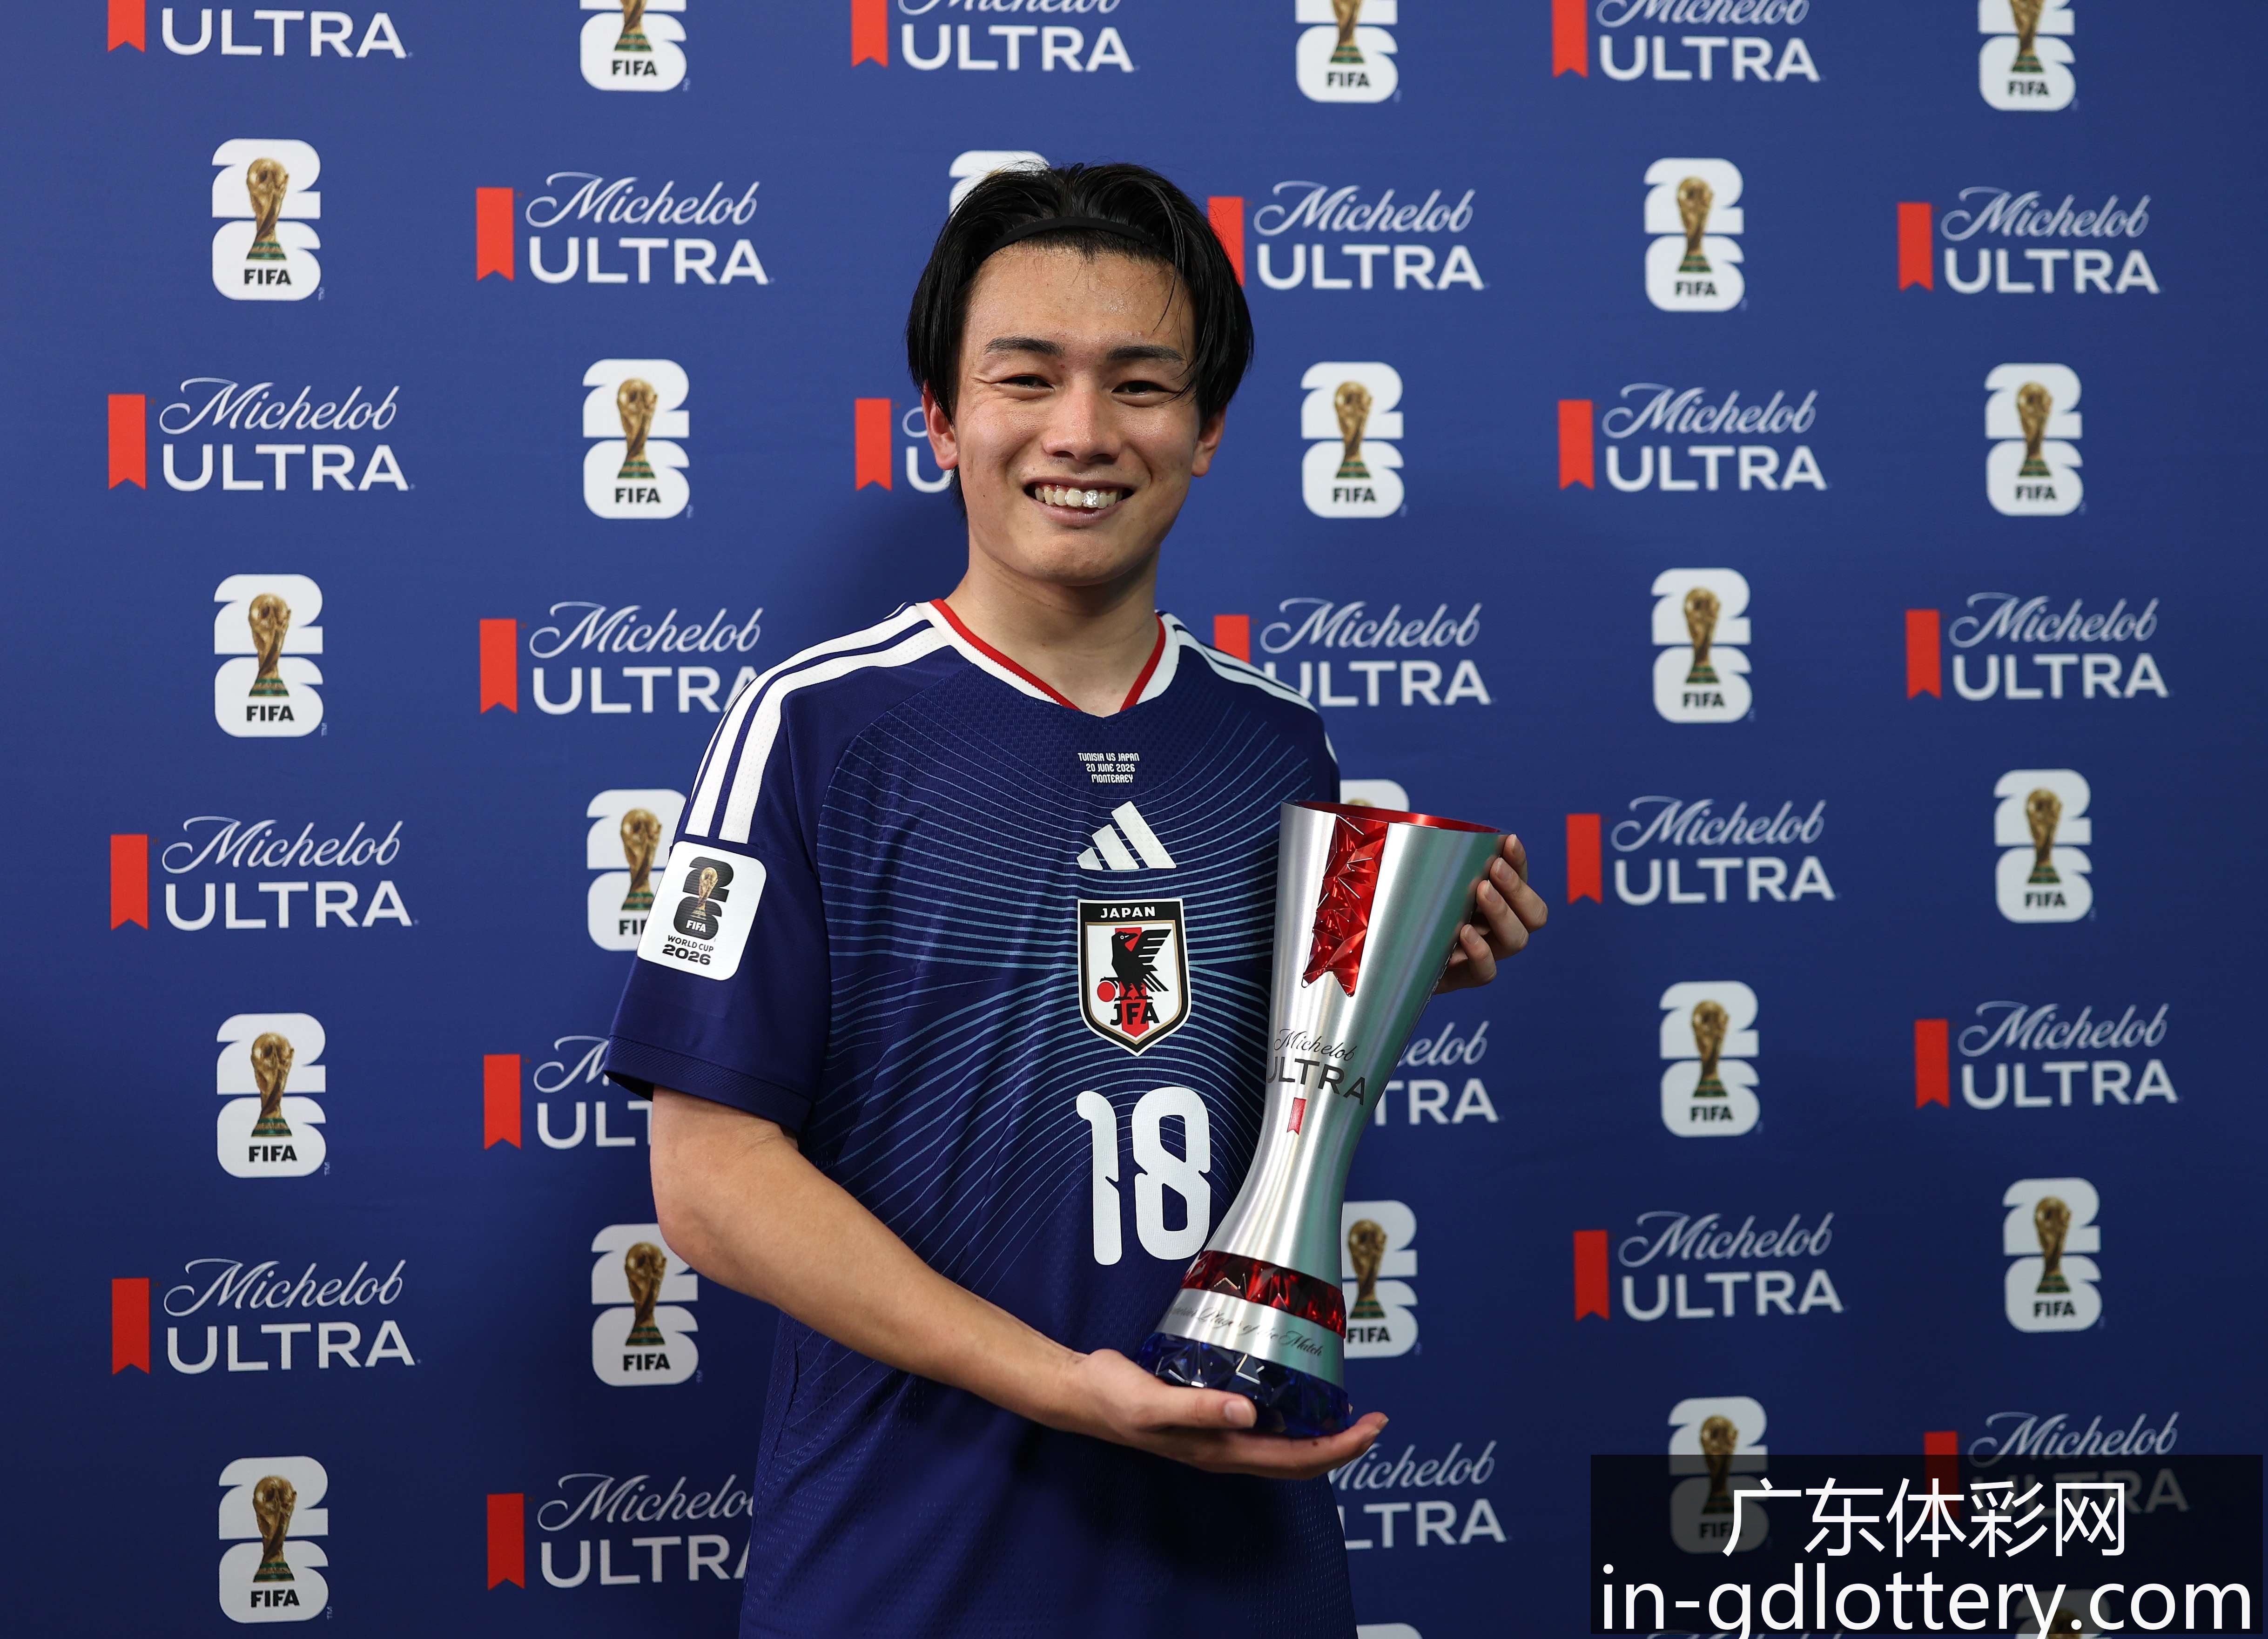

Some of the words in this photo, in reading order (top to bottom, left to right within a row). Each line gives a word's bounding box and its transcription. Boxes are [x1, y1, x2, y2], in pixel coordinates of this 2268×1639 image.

[162, 7, 407, 59] ULTRA
[901, 23, 1135, 73] ULTRA
[612, 60, 657, 76] FIFA
[1327, 72, 1370, 87] FIFA
[1599, 34, 1820, 82] ULTRA
[2008, 81, 2049, 95] FIFA
[525, 172, 760, 228] Michelob
[1253, 181, 1475, 236] Michelob
[1941, 186, 2151, 241] Michelob
[244, 269, 292, 285] FIFA
[529, 236, 769, 285] ULTRA
[1257, 243, 1485, 290] ULTRA
[1944, 248, 2160, 294] ULTRA
[1676, 281, 1717, 296] FIFA
[159, 377, 400, 435] Michelob
[1602, 383, 1818, 439] Michelob
[162, 443, 410, 492] ULTRA
[1606, 445, 1827, 492] ULTRA
[615, 487, 661, 504] FIFA
[1333, 487, 1376, 502] FIFA
[2016, 486, 2057, 499] FIFA
[529, 601, 763, 658] Michelob
[1260, 598, 1483, 654] Michelob
[1949, 592, 2159, 648] Michelob
[1683, 692, 1725, 707] FIFA
[1952, 653, 2168, 701] ULTRA
[246, 705, 295, 722] FIFA
[1077, 753, 1105, 762] TUNISIA
[1118, 753, 1140, 762] JAPAN
[1086, 763, 1096, 772] 20
[1097, 763, 1115, 772] JUNE
[1116, 763, 1136, 772] 2026
[1091, 774, 1133, 783] MONTERREY
[162, 816, 403, 874] Michelob
[1611, 796, 1826, 852] Michelob
[1615, 856, 1836, 906] ULTRA
[2025, 892, 2066, 907] FIFA
[165, 880, 413, 931] ULTRA
[686, 919, 707, 933] FIFA
[1100, 907, 1156, 918] JAPAN
[662, 944, 712, 965] 2026
[667, 935, 698, 949] WORLD
[698, 943, 714, 952] CUP
[1110, 1002, 1160, 1025] JFA
[1958, 1001, 2168, 1057] Michelob
[1273, 1028, 1358, 1061] Michelob
[1961, 1059, 2178, 1110] ULTRA
[1690, 1106, 1733, 1121] FIFA
[248, 1145, 298, 1163] FIFA
[1076, 1086, 1211, 1265] 18
[1618, 1211, 1834, 1268] Michelob
[163, 1258, 406, 1317] Michelob
[1622, 1268, 1844, 1322] ULTRA
[2033, 1301, 2076, 1317] FIFA
[167, 1320, 416, 1375] ULTRA
[1347, 1327, 1391, 1344] FIFA
[623, 1353, 671, 1371] FIFA
[1967, 1411, 2180, 1468] Michelob
[537, 1473, 753, 1531] Michelo
[250, 1589, 300, 1608] FIFA
